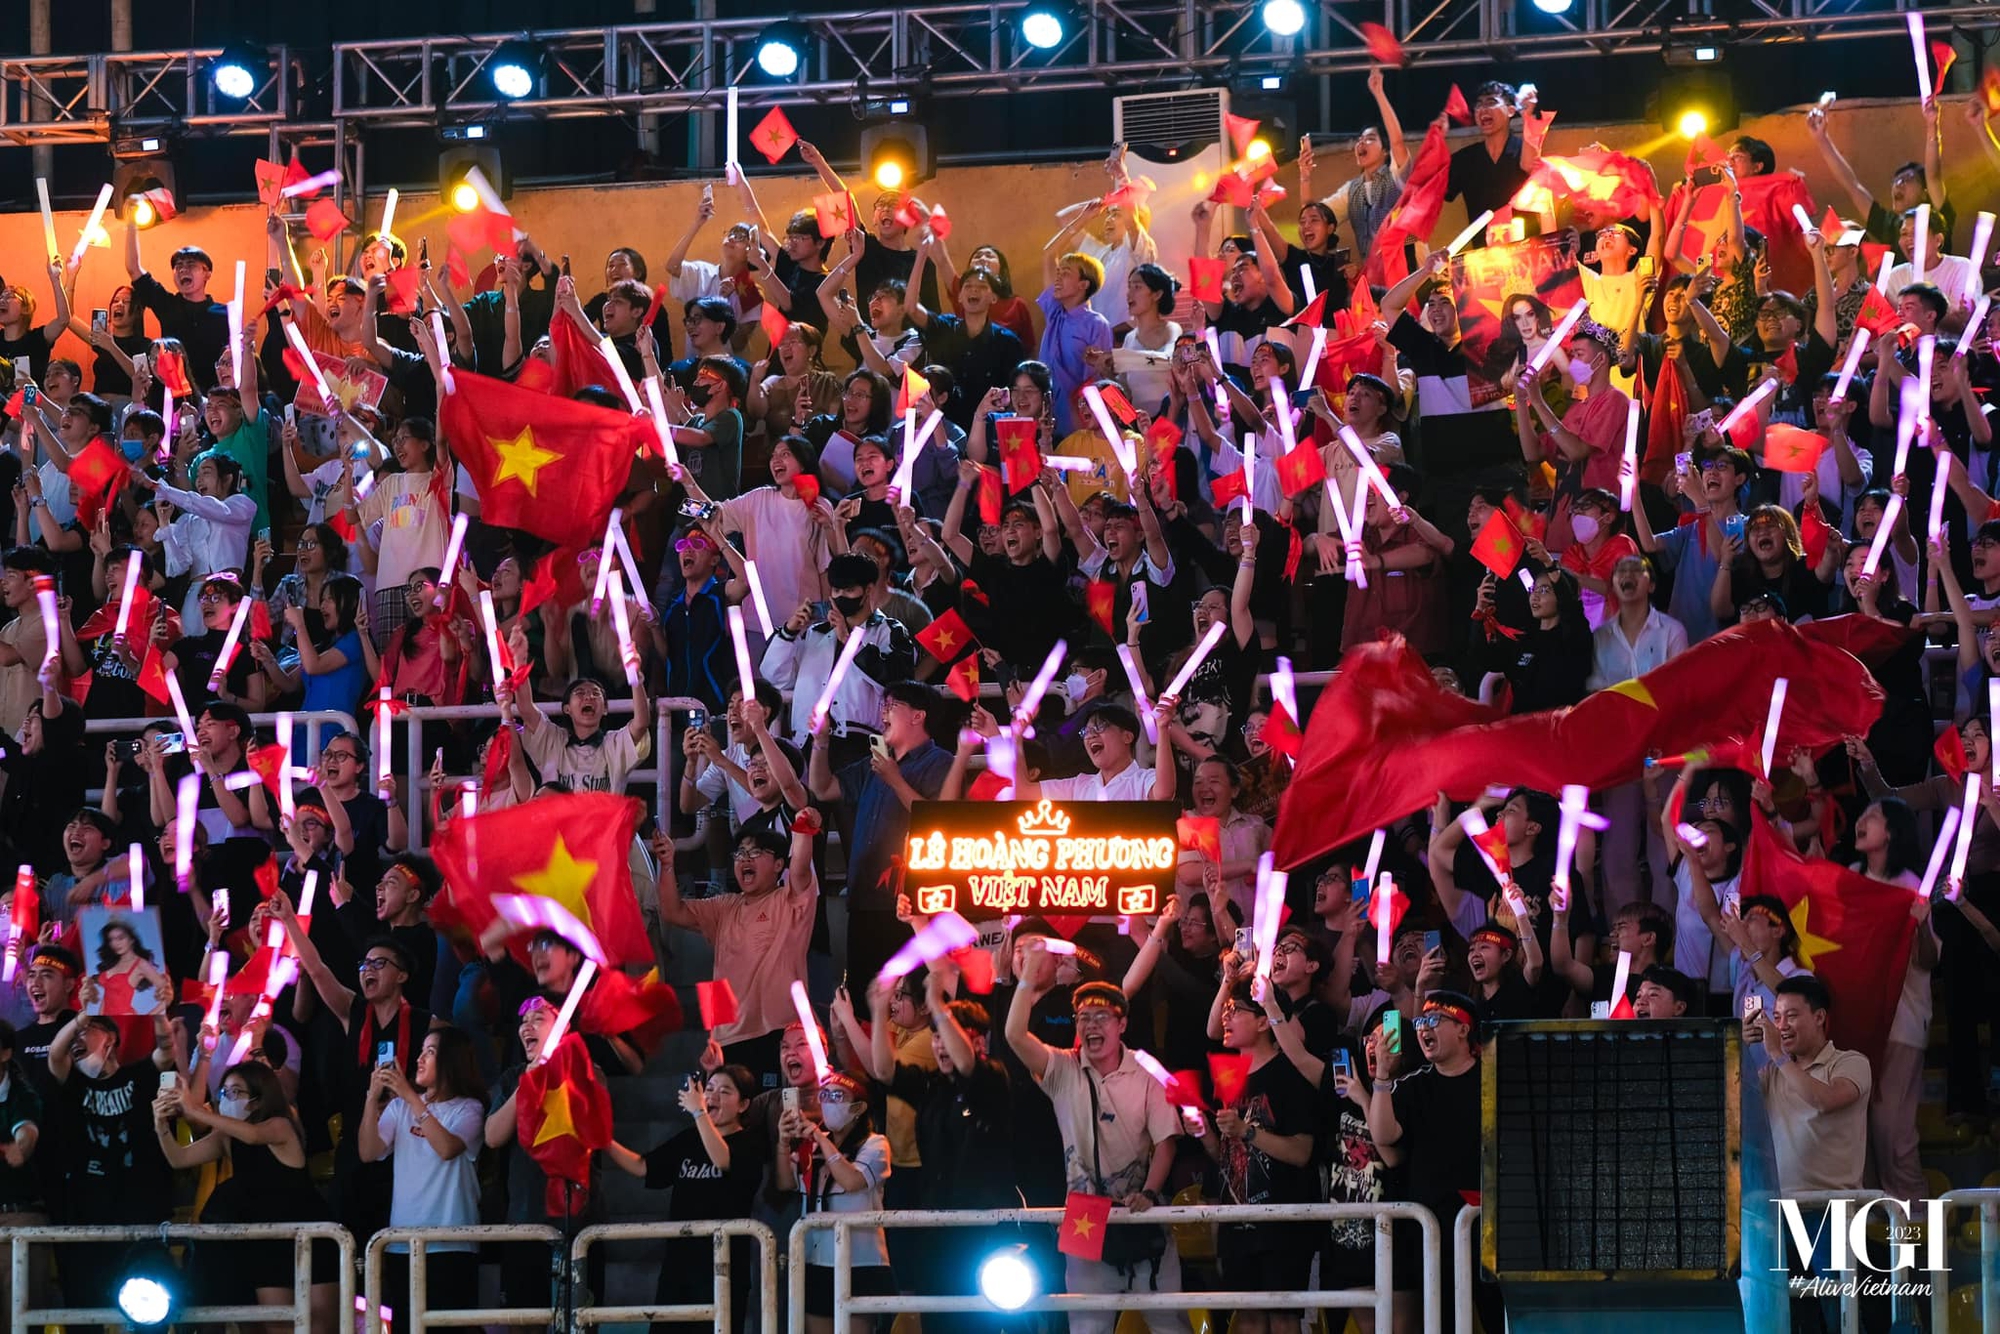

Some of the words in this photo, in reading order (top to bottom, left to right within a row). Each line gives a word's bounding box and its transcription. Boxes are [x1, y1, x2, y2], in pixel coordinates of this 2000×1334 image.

[908, 831, 948, 870] LÊ
[949, 831, 1051, 870] HOÀNG
[968, 869, 1037, 912] VIỆT
[1038, 875, 1110, 908] NAM
